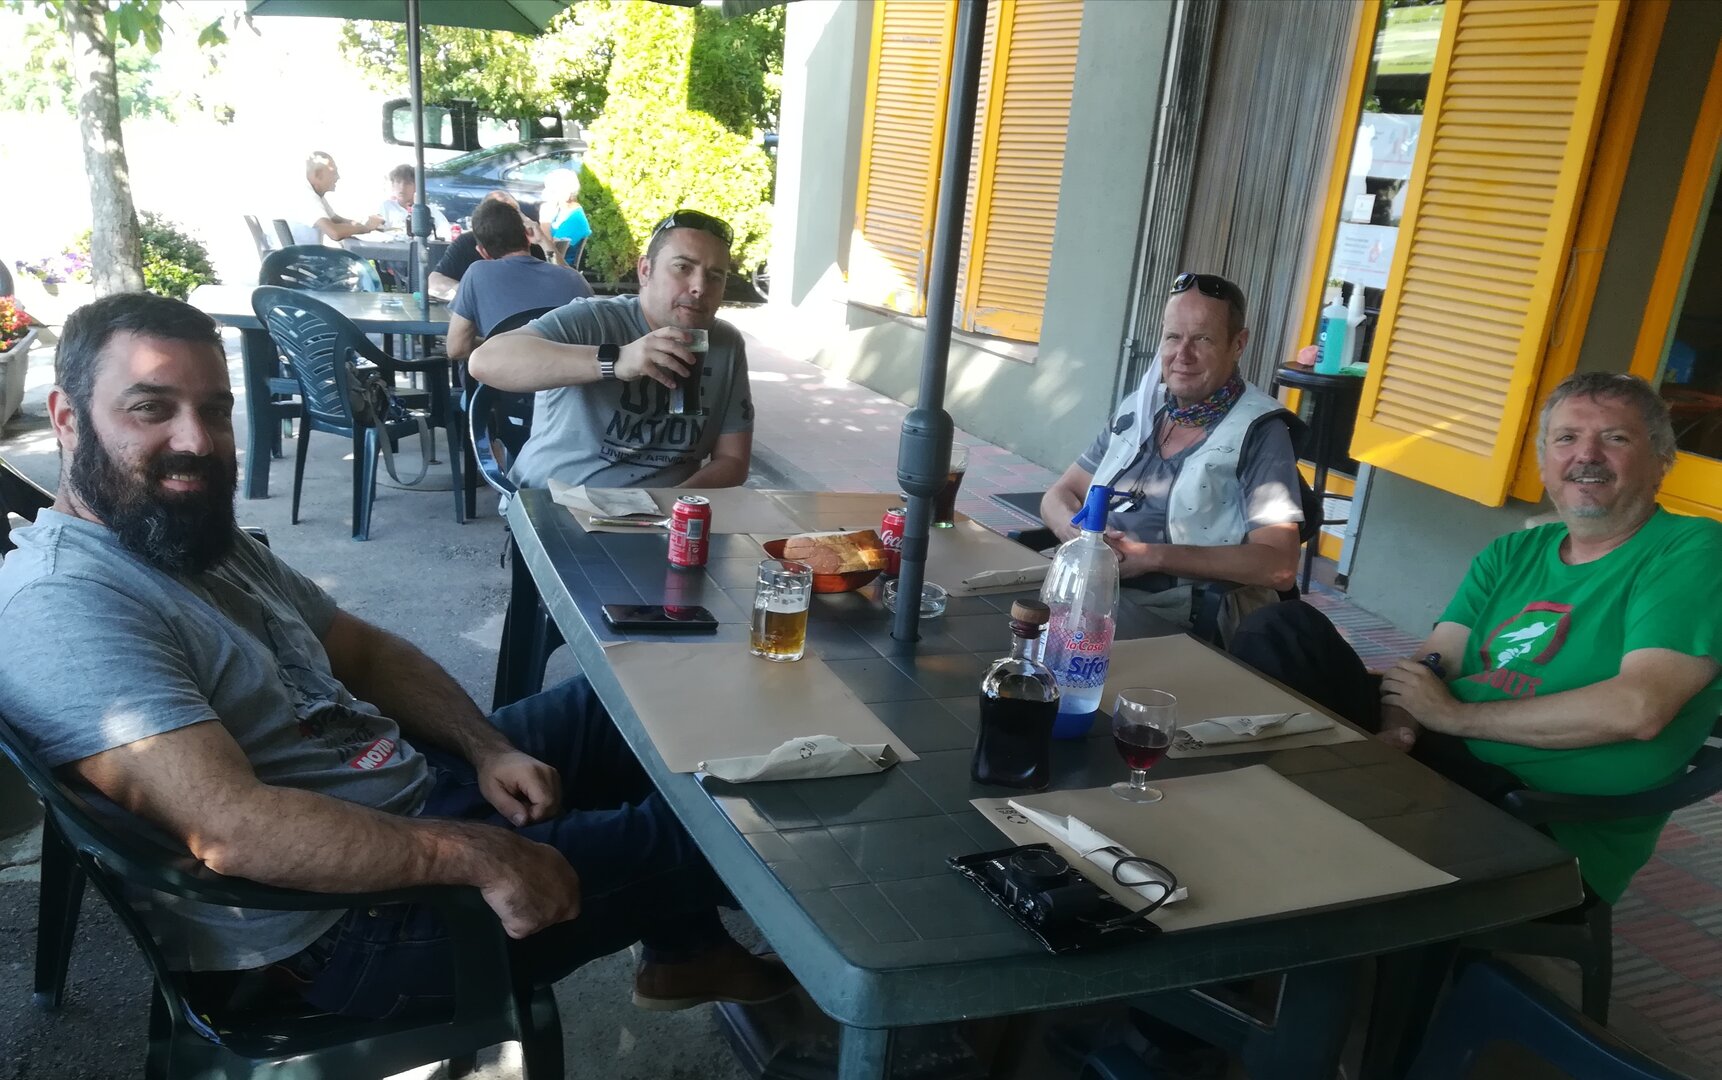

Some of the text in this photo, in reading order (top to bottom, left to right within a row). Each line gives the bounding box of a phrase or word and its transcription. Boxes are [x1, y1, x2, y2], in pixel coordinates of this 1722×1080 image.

[606, 409, 707, 446] NATION
[1079, 639, 1104, 652] Casa
[356, 738, 395, 770] MOTUL
